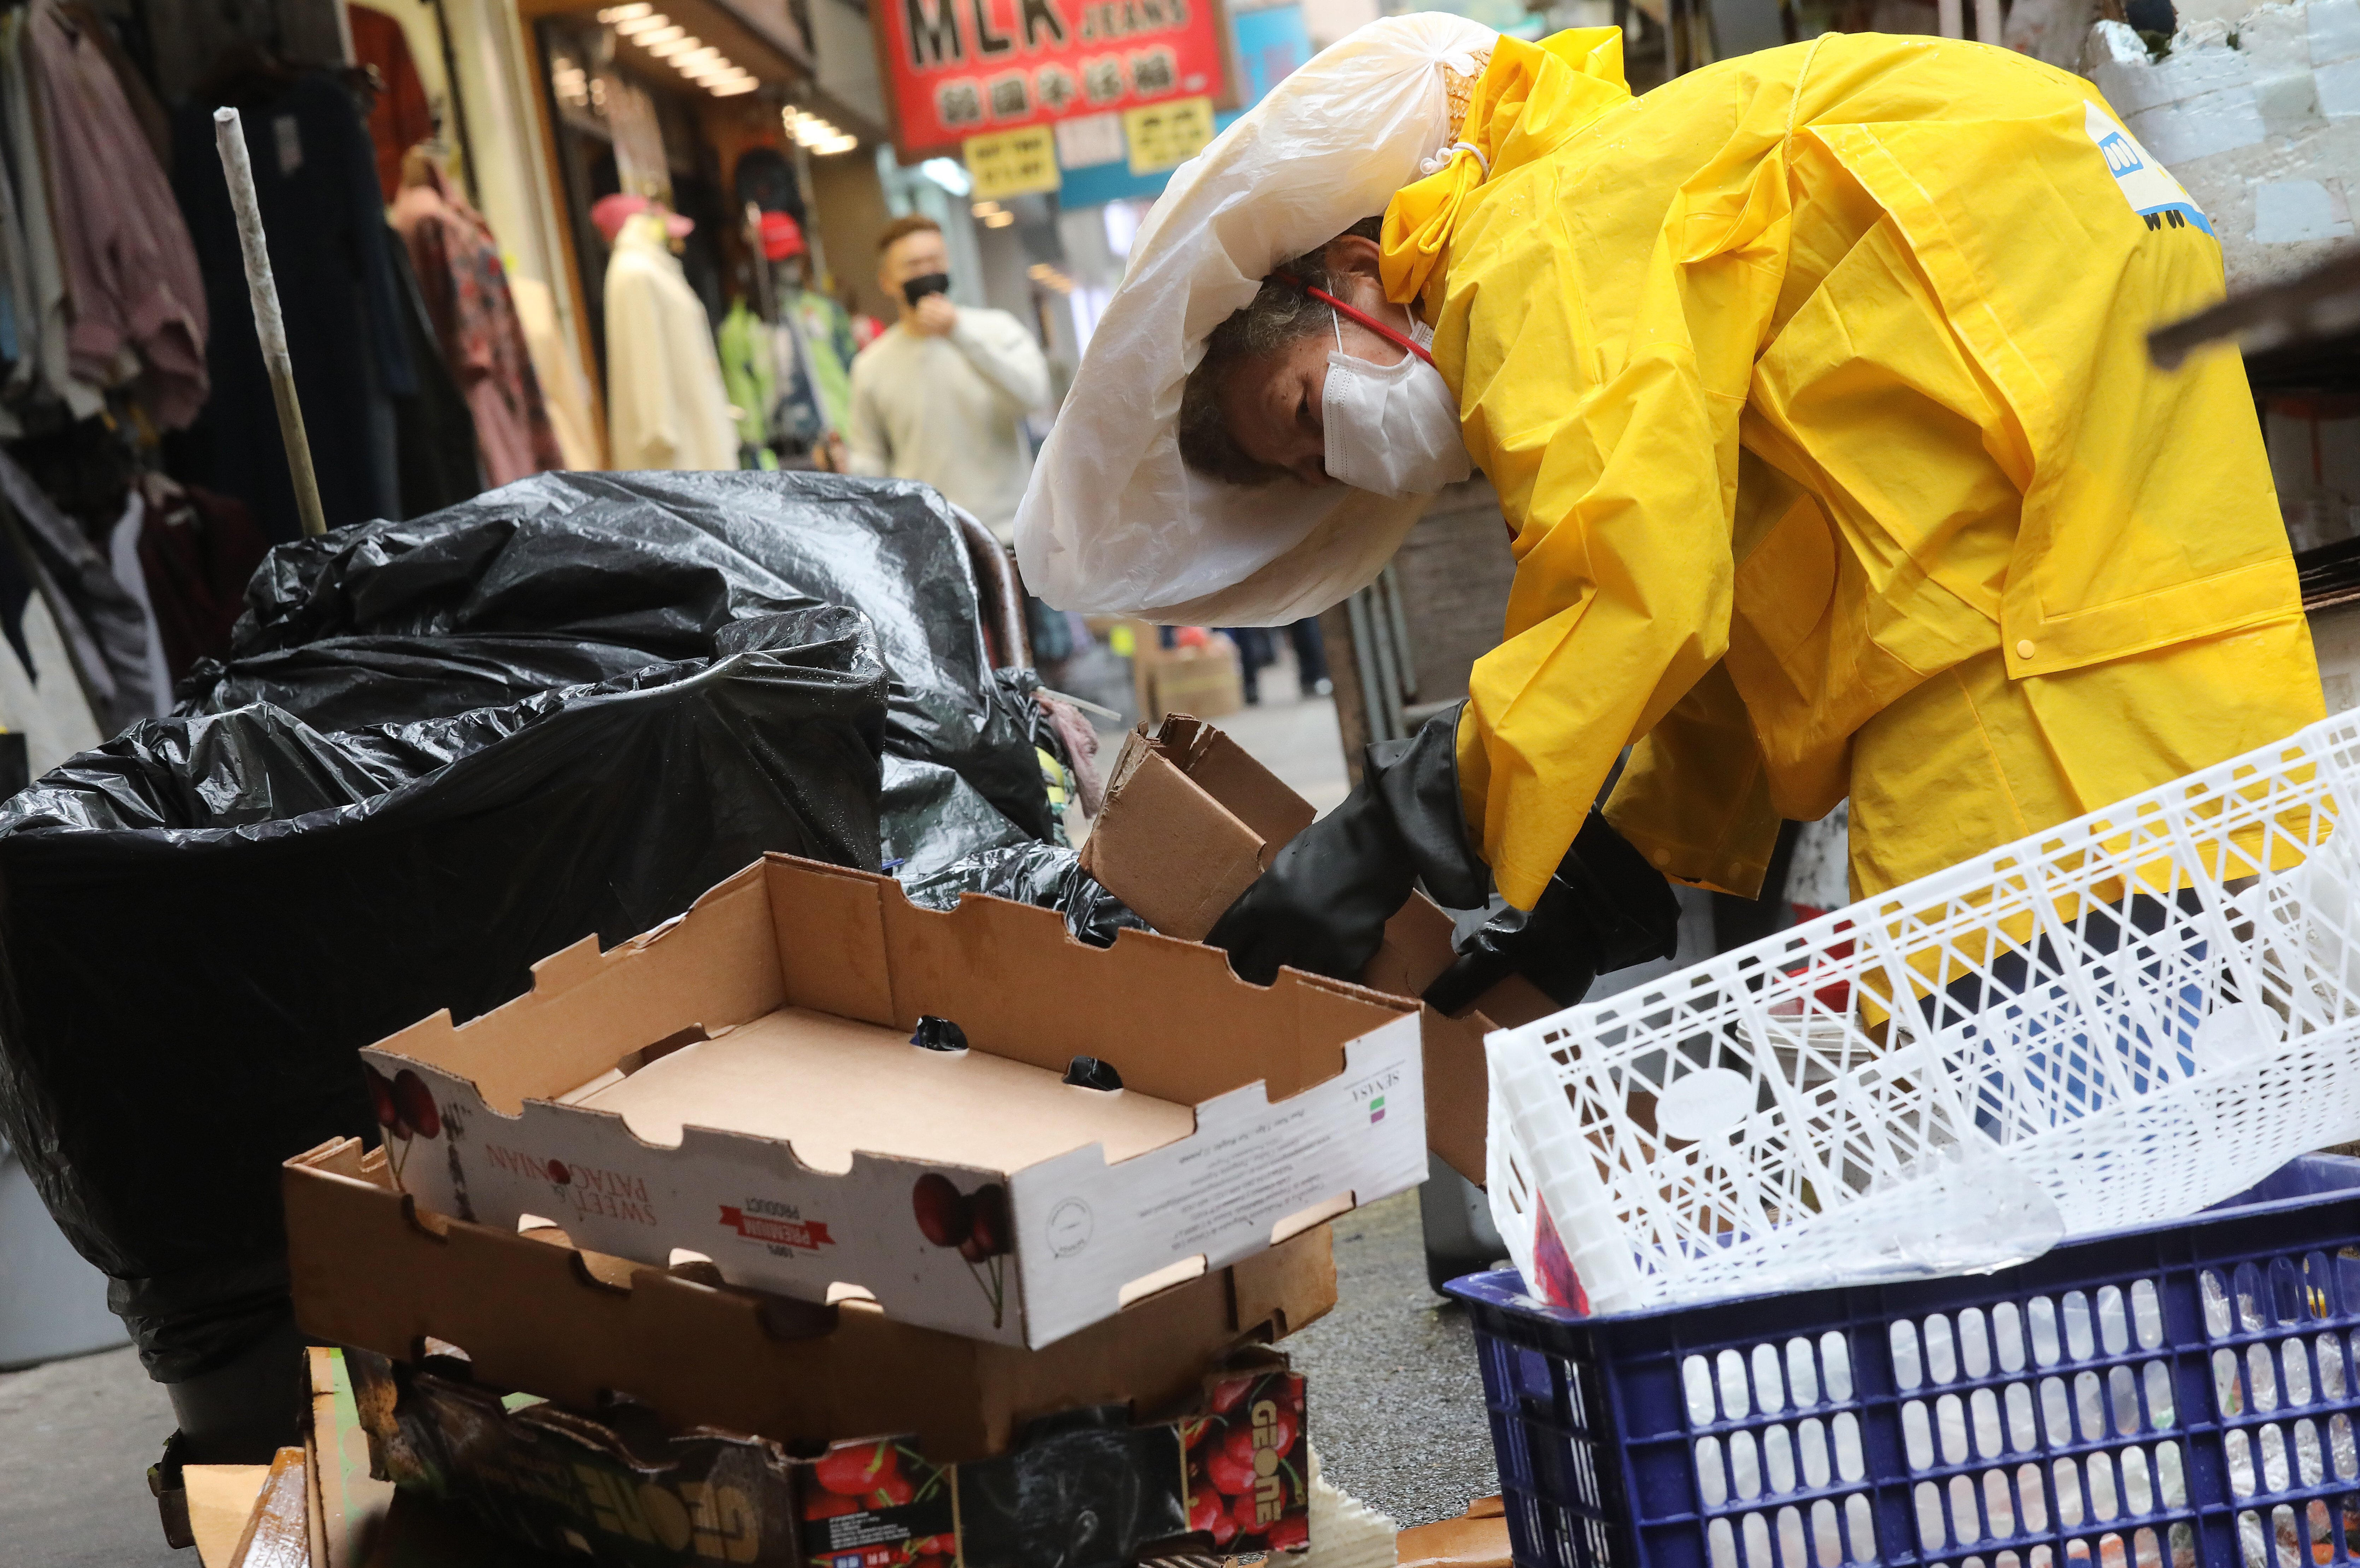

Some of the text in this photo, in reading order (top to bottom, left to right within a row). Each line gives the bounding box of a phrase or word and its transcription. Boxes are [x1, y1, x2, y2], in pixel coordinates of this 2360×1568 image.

[576, 1188, 658, 1226] SWEET
[743, 1217, 811, 1246] PREMIUM
[1251, 1399, 1282, 1526] GEONE
